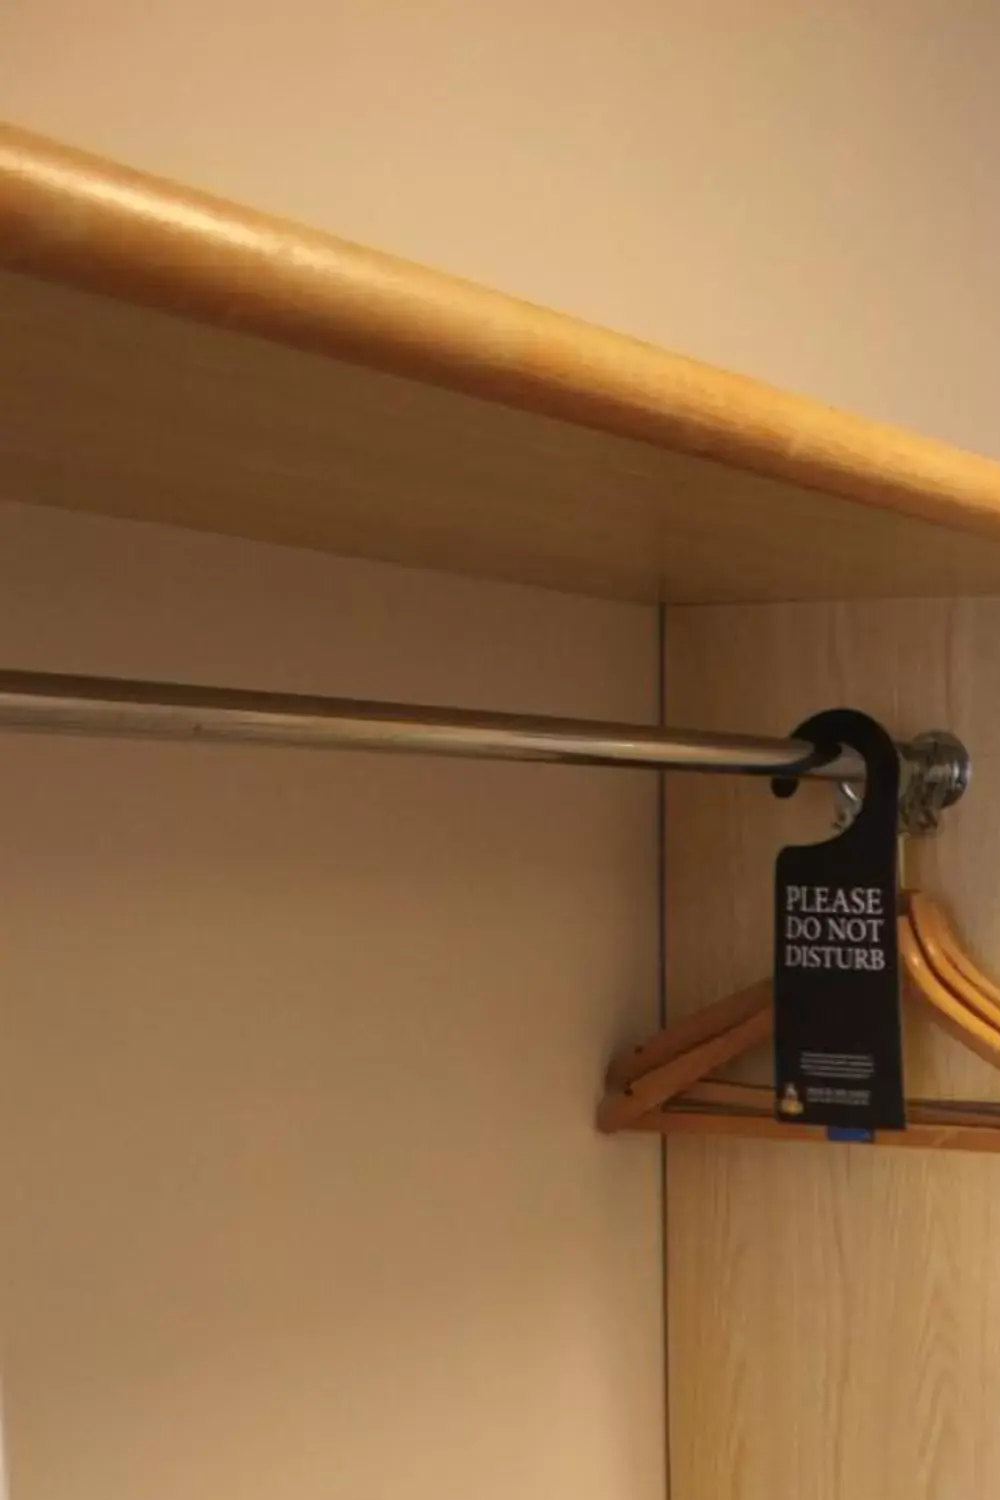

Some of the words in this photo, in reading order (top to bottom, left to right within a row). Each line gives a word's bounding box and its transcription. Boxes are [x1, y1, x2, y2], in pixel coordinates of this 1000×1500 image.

[786, 885, 884, 915] PLEASE
[785, 916, 822, 941] DO
[827, 917, 886, 943] NOT
[785, 944, 886, 971] DISTURB
